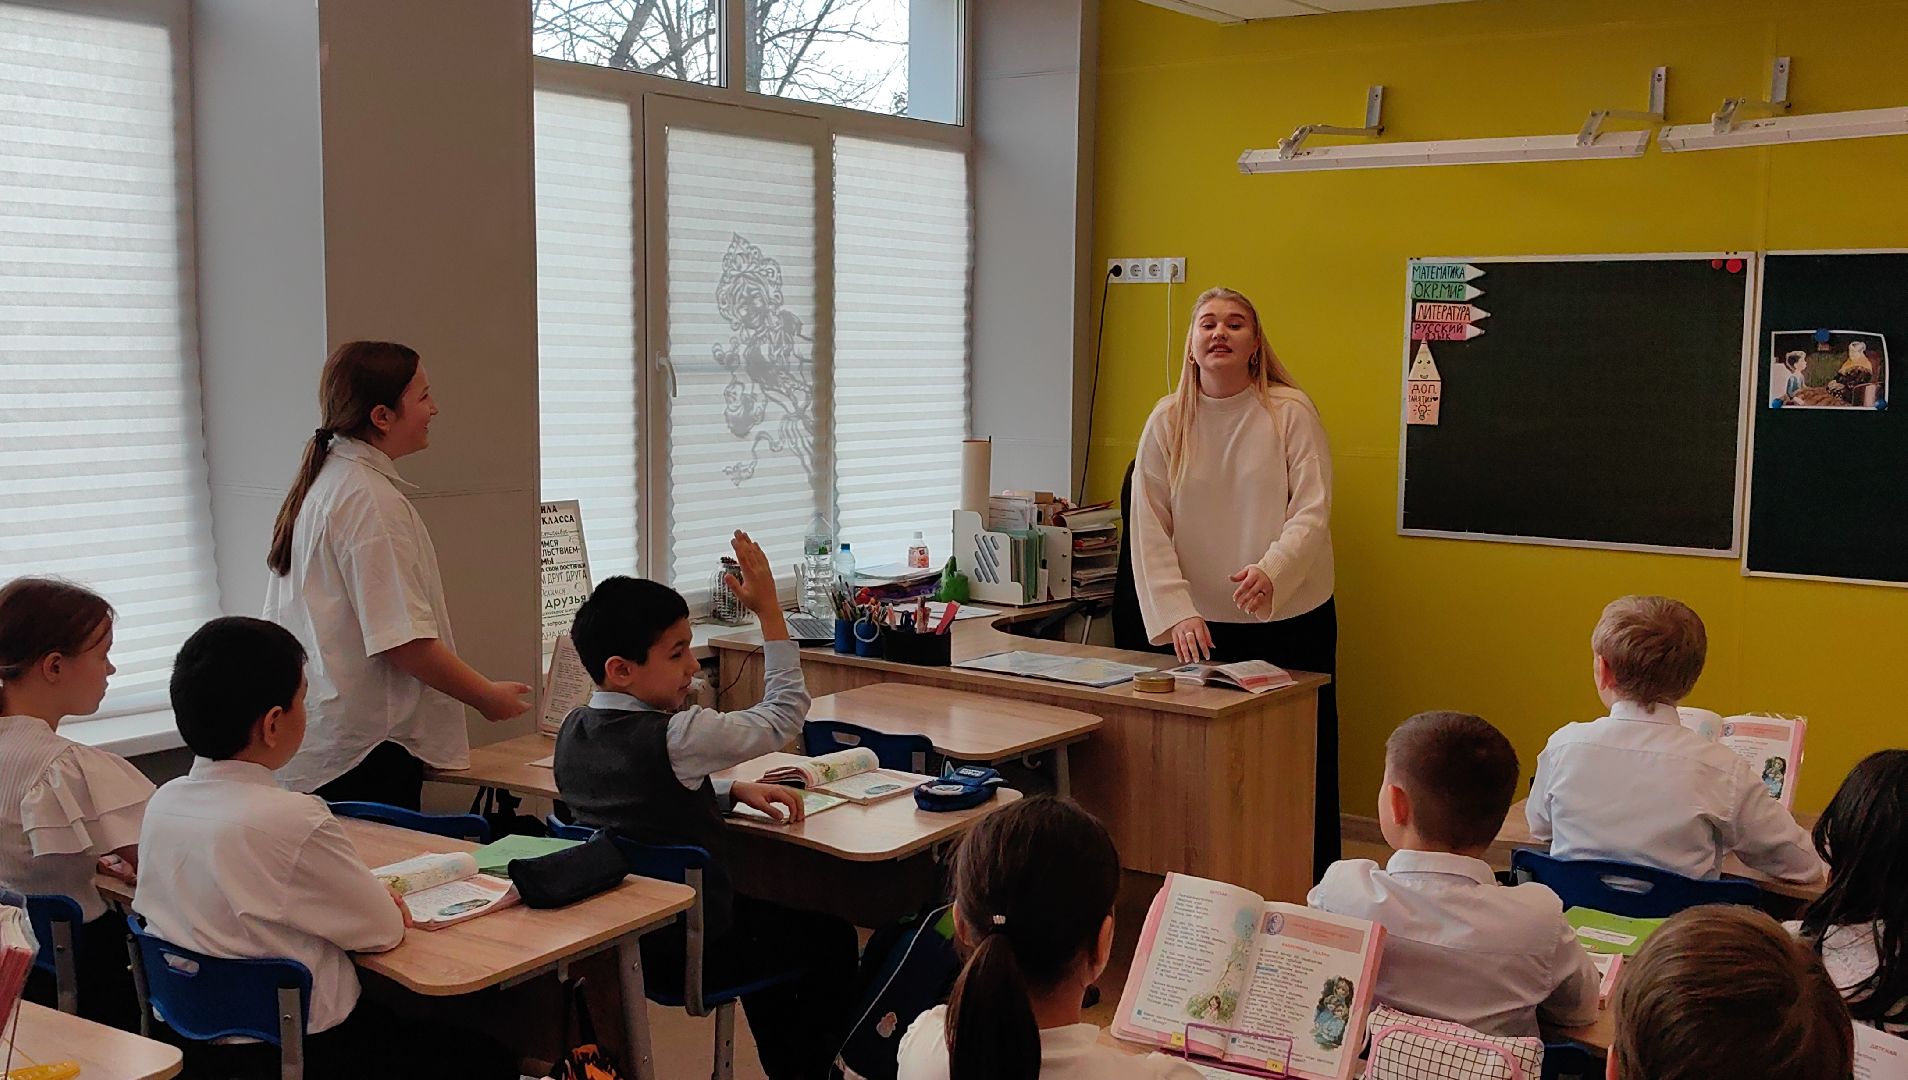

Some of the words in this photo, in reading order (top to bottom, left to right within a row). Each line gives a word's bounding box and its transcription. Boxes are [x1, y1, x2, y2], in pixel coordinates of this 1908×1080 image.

[1412, 265, 1465, 281] МАТЕМАТИКА
[1414, 282, 1464, 298] ОКР.МИР
[1418, 305, 1471, 321] ЛИТЕРАТУРА
[1414, 322, 1463, 334] РУССКИЙ
[542, 514, 575, 525] КЛАССА
[547, 572, 563, 585] ДРУГ
[565, 570, 588, 583] ДРУГА
